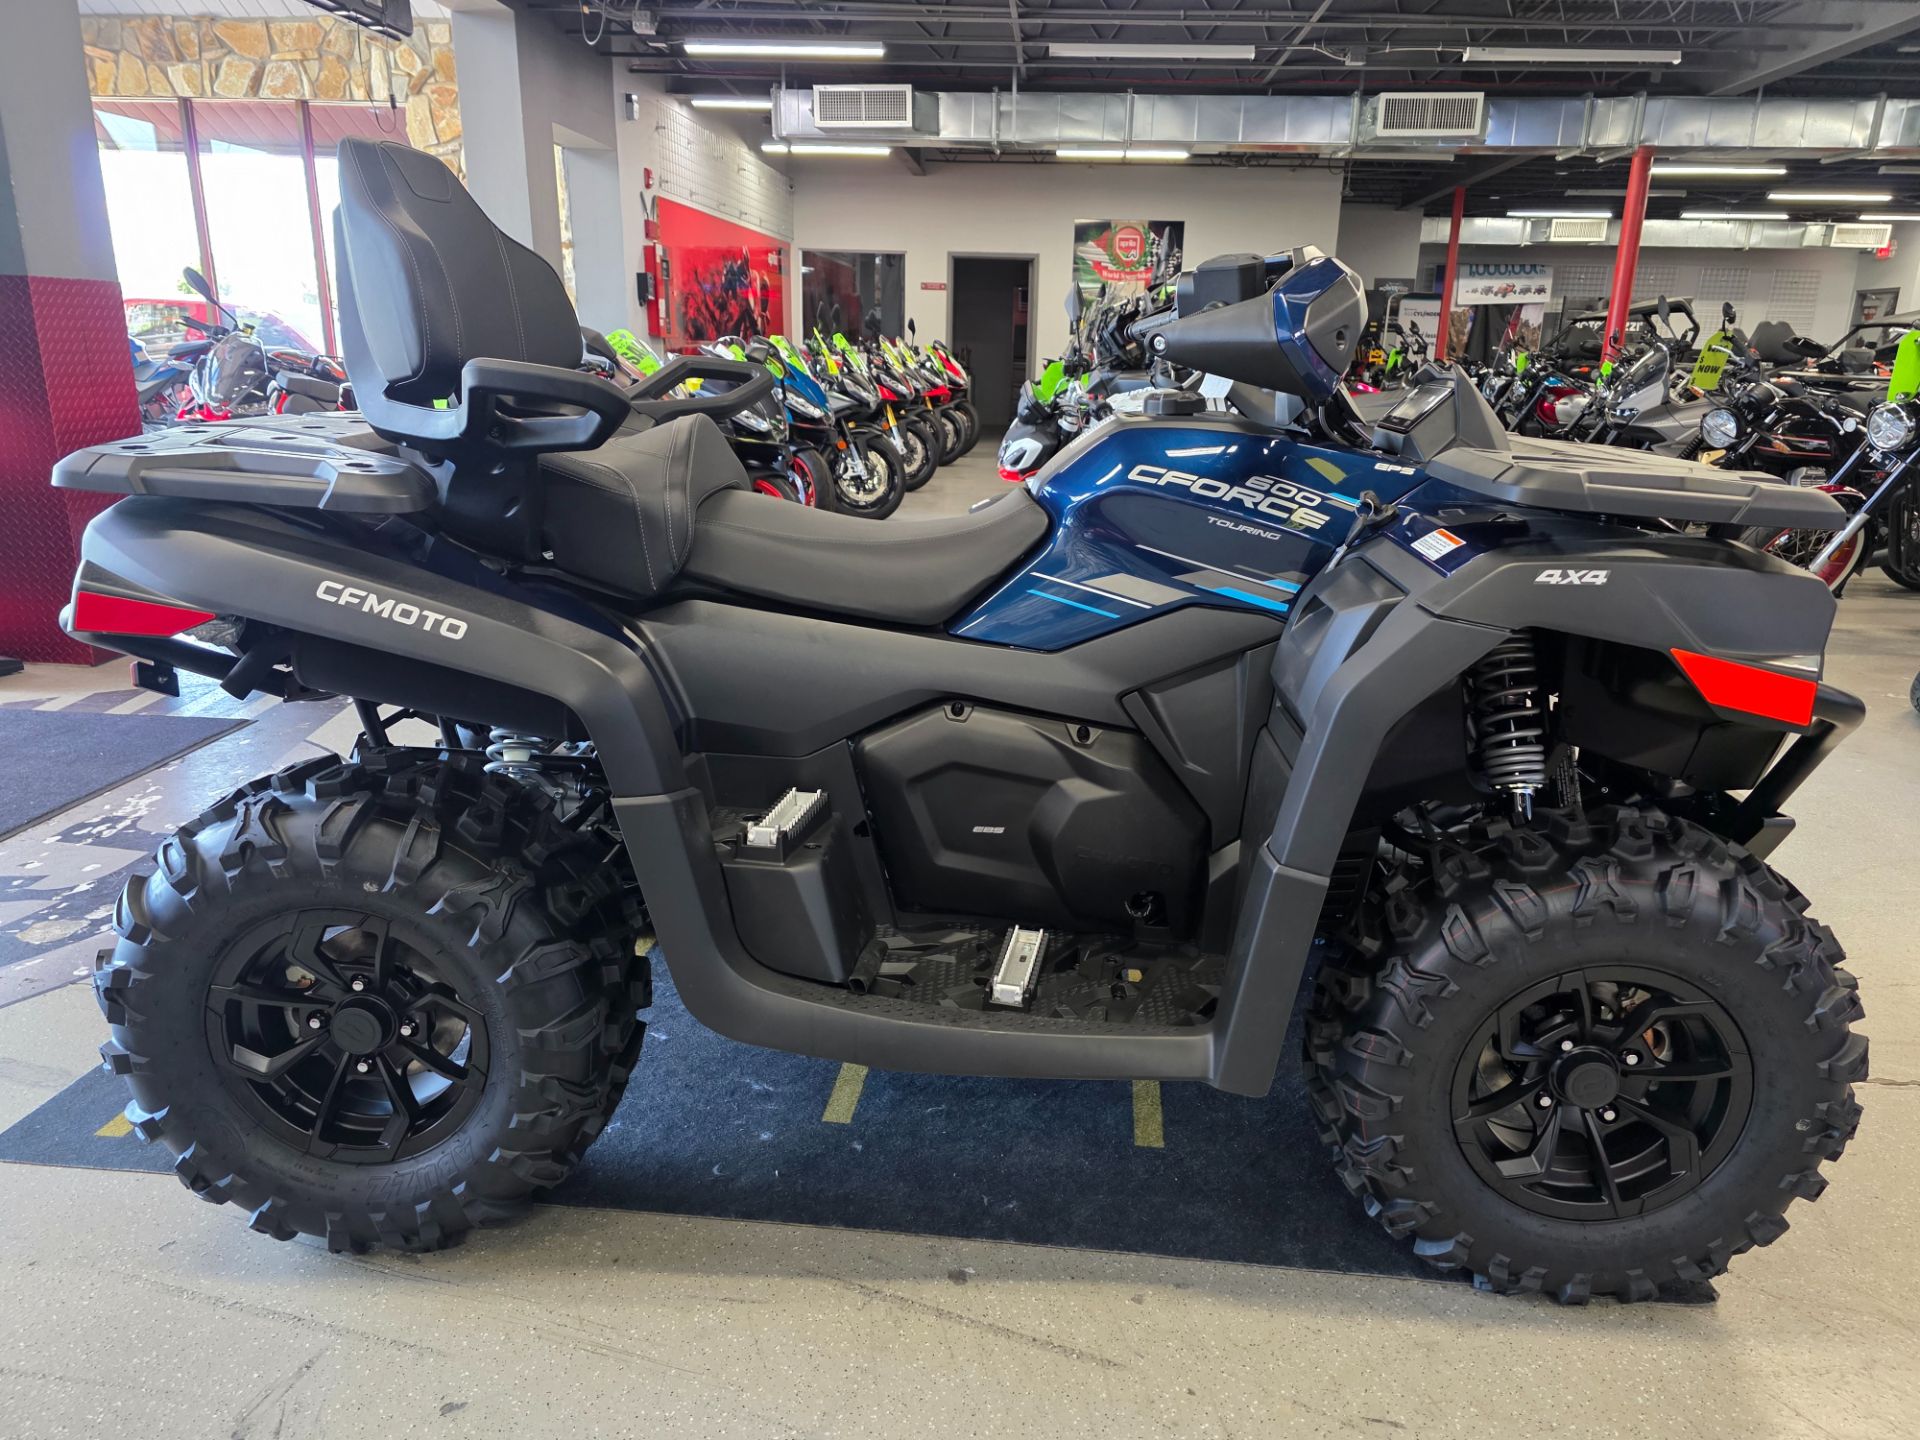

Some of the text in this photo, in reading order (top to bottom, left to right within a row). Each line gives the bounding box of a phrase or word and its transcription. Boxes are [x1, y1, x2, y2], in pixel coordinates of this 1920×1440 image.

[1697, 365, 1720, 374] NOW
[1374, 462, 1416, 475] EPS
[1127, 464, 1330, 530] CFORCE
[1245, 475, 1322, 507] 600
[1207, 516, 1281, 540] TOURING
[316, 580, 468, 640] CFMOTO
